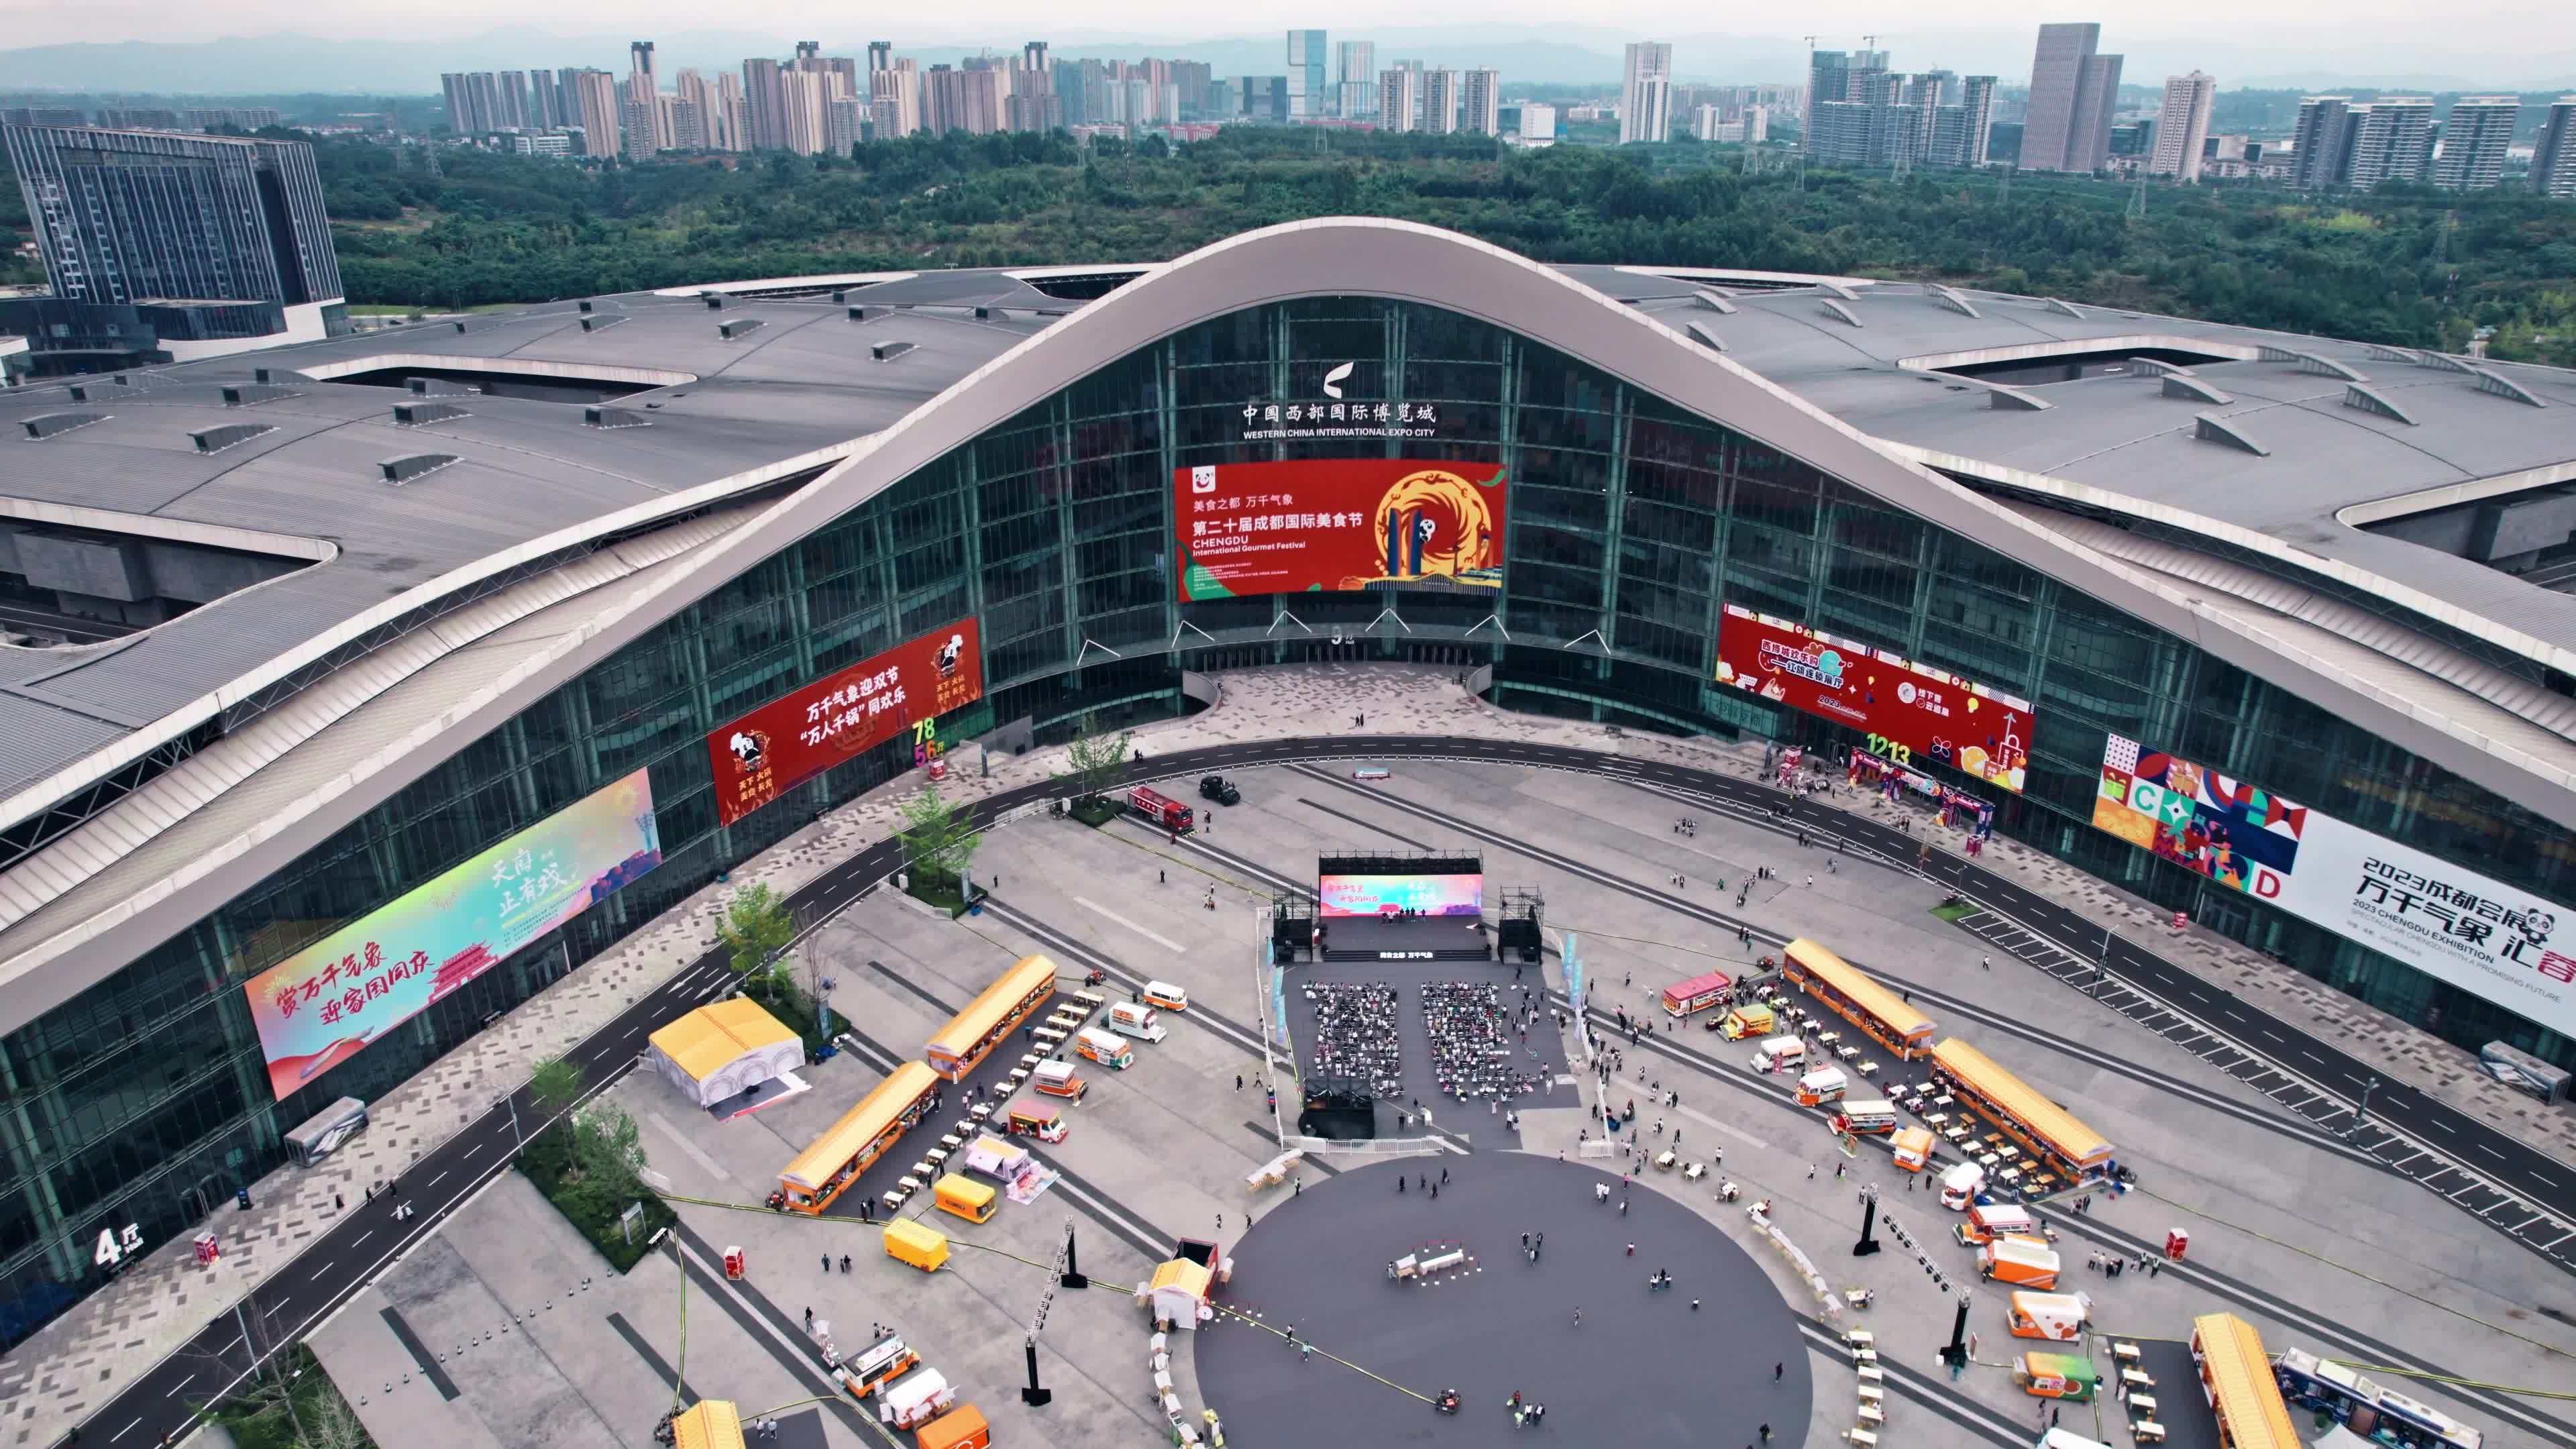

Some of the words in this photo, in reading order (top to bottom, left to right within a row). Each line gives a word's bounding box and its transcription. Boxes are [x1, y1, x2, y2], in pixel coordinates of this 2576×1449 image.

[1242, 402, 1436, 426] 中国西部国际博览城
[1244, 429, 1286, 439] WESTERN
[1287, 429, 1314, 437] CHINA
[1316, 427, 1387, 437] INTERNATIONAL
[1389, 428, 1412, 436] EXPO
[1415, 429, 1436, 437] CITY
[1193, 496, 1240, 513] 美食之都
[1246, 493, 1293, 508] 万千气象
[1193, 512, 1363, 537] 第二十届成都国际美食节
[1193, 535, 1248, 549] CHENGDU
[1193, 544, 1240, 557] International
[1242, 543, 1275, 553] Gourmet
[1277, 541, 1305, 550] Festival
[1762, 639, 1820, 667] 西博城欢乐购
[806, 665, 898, 723] 万千气象迎双节
[2353, 898, 2376, 913] 2023
[2378, 909, 2429, 935] CHENGDU
[2431, 930, 2495, 964] EXHIBITION
[276, 941, 387, 1019] 赏万千气象
[320, 951, 435, 1026] 迎家国同庆
[2526, 983, 2561, 1004] FUTURE
[95, 1228, 122, 1265] 4
